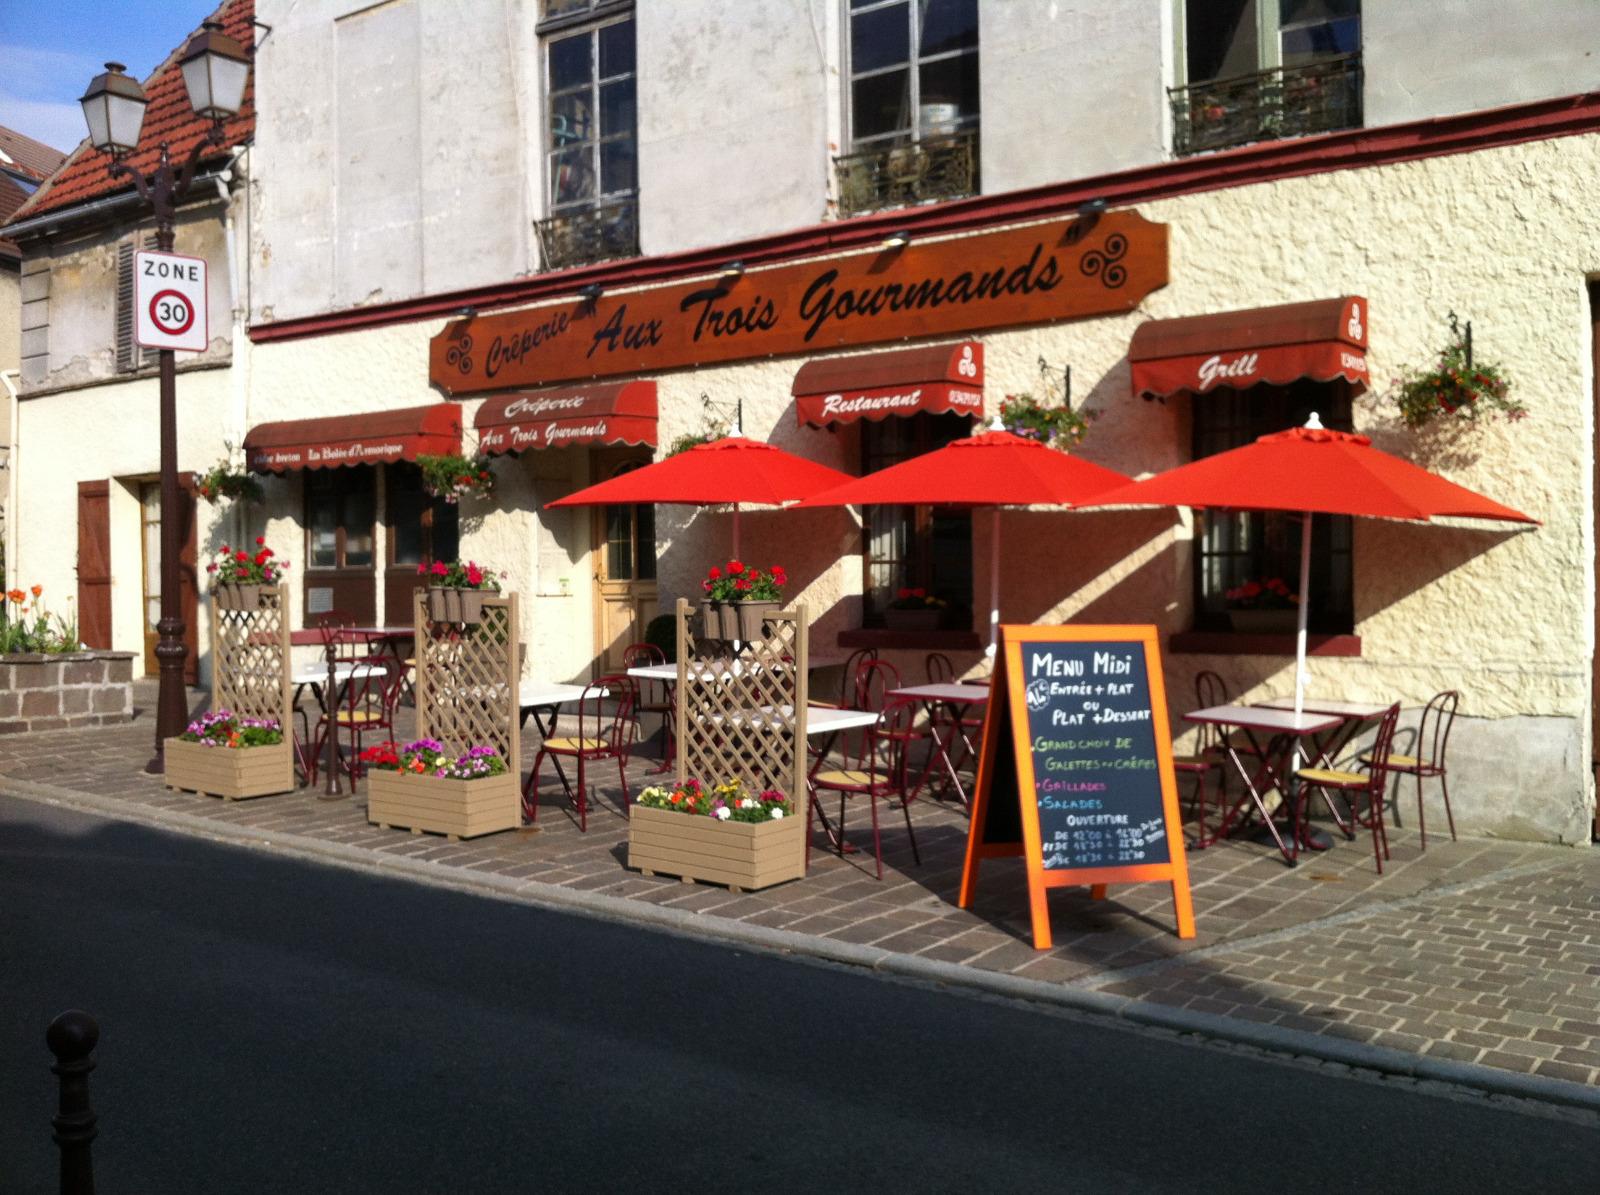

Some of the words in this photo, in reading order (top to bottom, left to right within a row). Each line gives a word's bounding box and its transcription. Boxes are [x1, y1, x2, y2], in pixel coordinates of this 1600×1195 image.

[144, 260, 199, 281] ZONE
[159, 302, 186, 323] 30
[485, 311, 570, 378] Crêperie
[586, 304, 665, 359] Aux
[680, 288, 779, 342] Trois
[799, 243, 1064, 342] Gourmands
[1198, 353, 1259, 391] Grill
[821, 390, 922, 418] Restaurant
[480, 430, 504, 449] Aux
[510, 426, 538, 444] Trois
[545, 420, 607, 446] Gourmands
[1031, 652, 1084, 678] MENU
[1093, 651, 1132, 675] MiDi
[1107, 683, 1134, 696] PLAT
[1082, 701, 1100, 712] OU
[1052, 709, 1085, 726] PLAT
[1115, 738, 1132, 749] DE
[1044, 796, 1103, 809] SALADES
[1066, 814, 1128, 827] OUVERTURE
